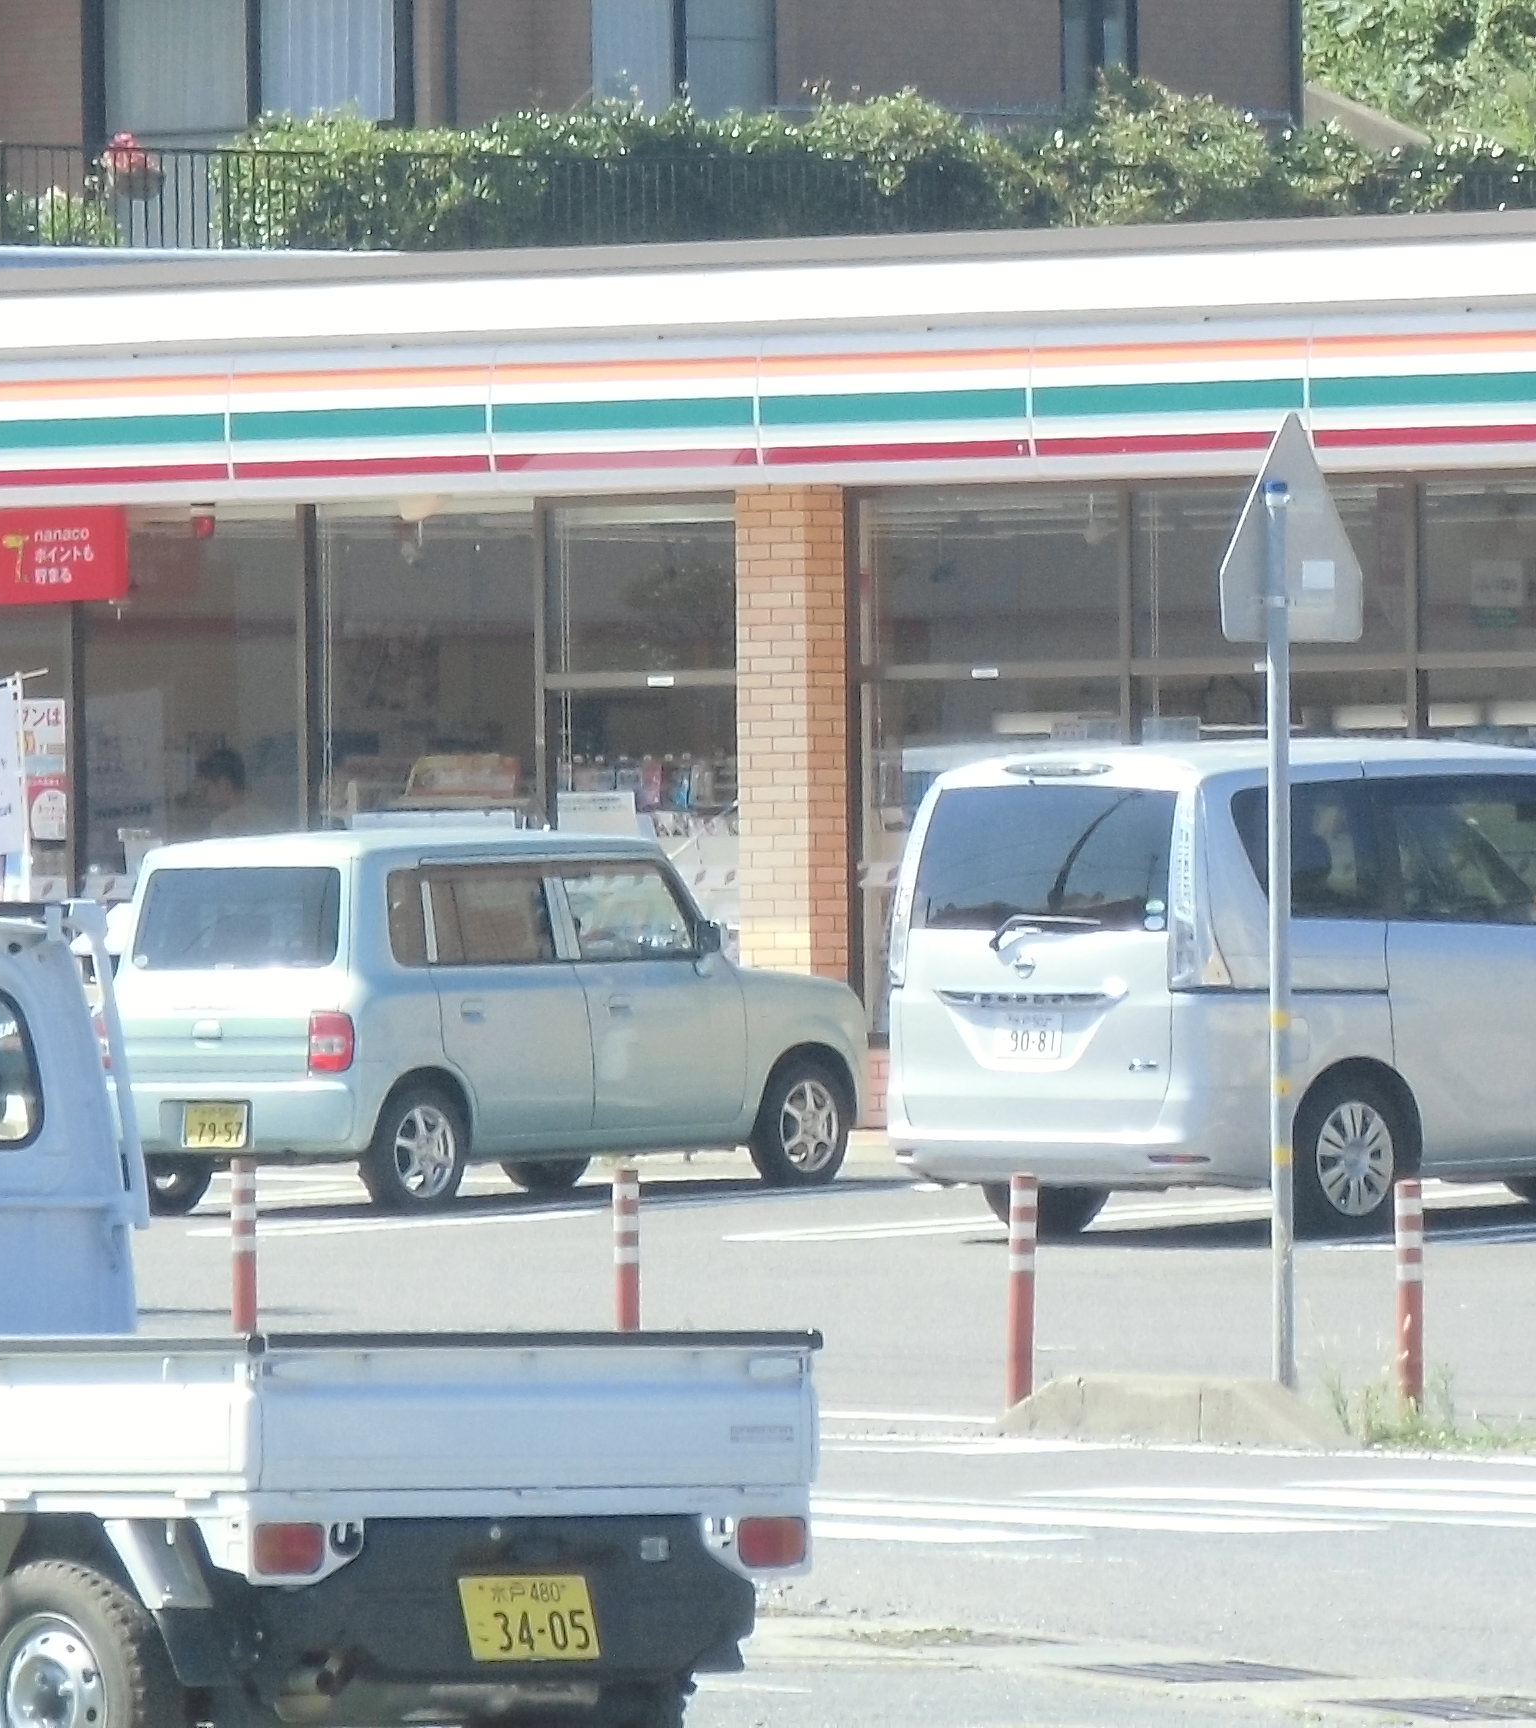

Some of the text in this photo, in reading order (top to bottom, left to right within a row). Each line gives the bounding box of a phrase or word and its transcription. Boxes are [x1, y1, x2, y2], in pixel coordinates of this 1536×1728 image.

[33, 527, 91, 543] nanaco
[34, 545, 95, 563] ポイントも
[1010, 1029, 1056, 1053] 90-81
[198, 1121, 243, 1143] 79-57
[529, 1581, 562, 1603] 480
[492, 1608, 591, 1652] 34-05
